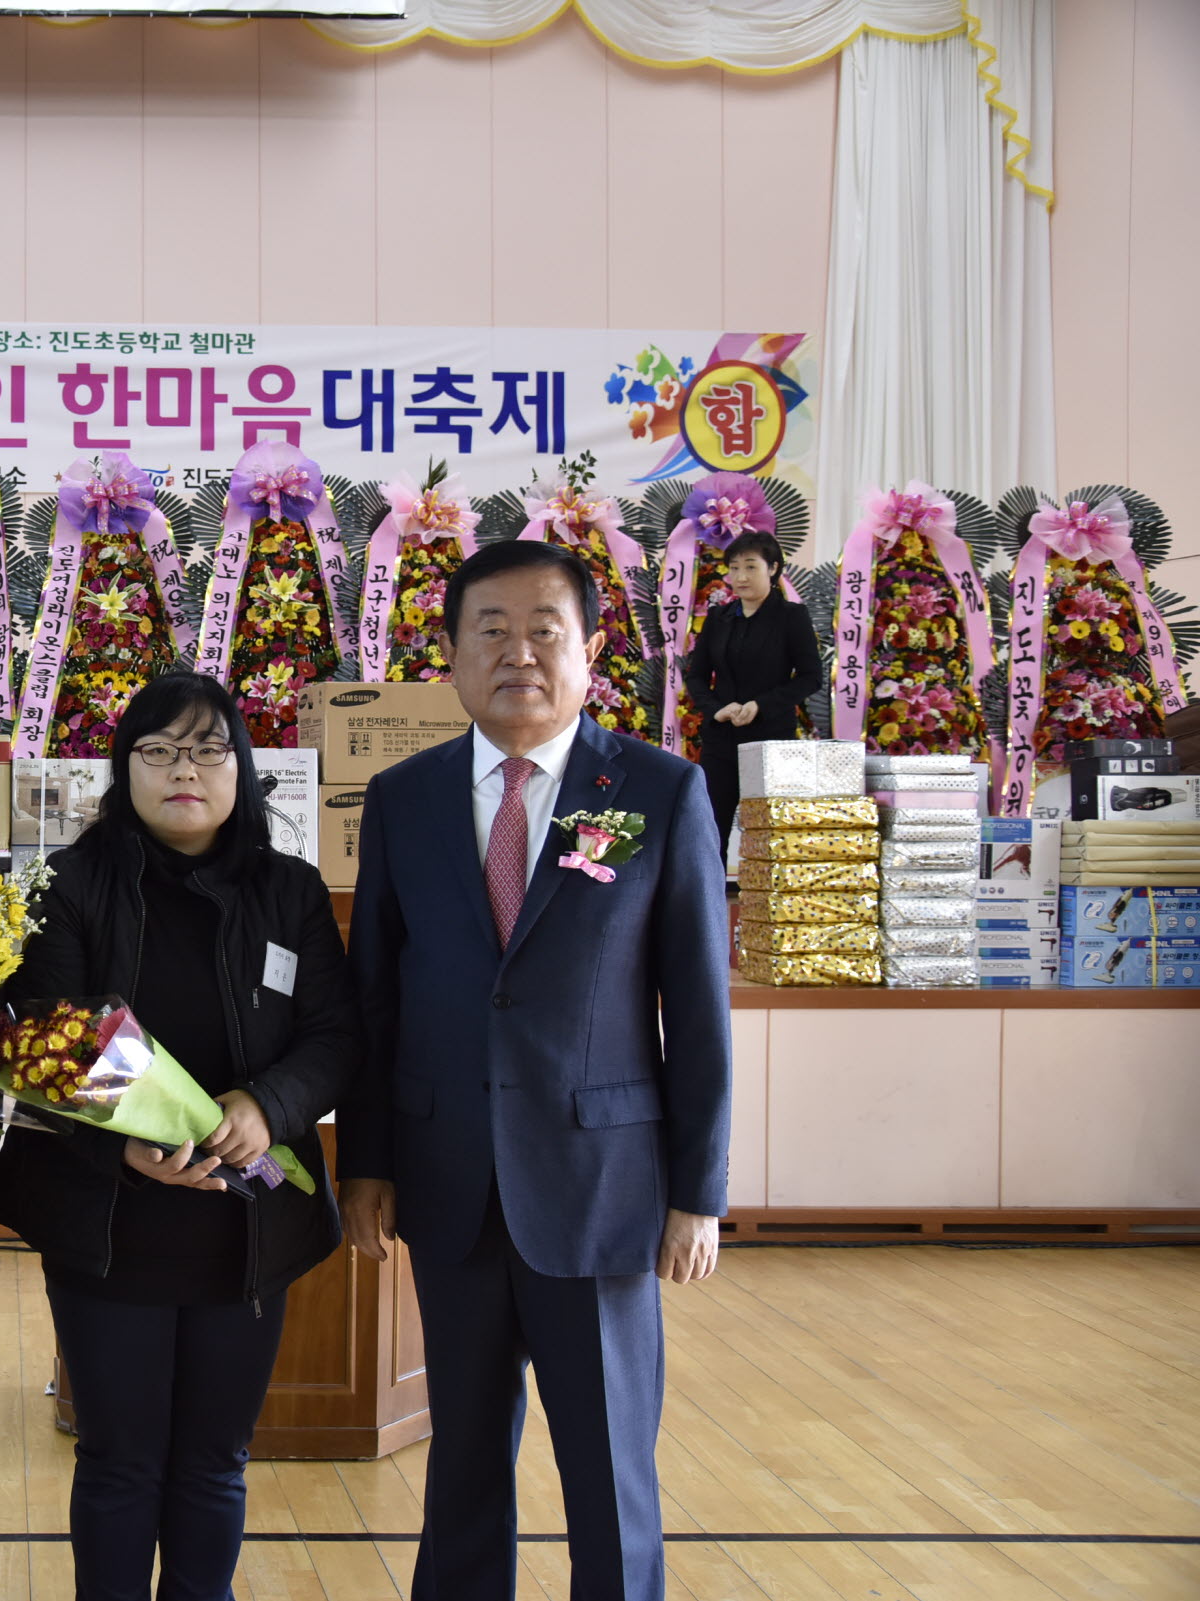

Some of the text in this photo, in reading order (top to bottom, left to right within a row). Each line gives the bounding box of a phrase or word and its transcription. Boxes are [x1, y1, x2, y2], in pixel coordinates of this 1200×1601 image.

[49, 332, 183, 354] 진도초등학교
[189, 333, 256, 354] 철마관
[57, 362, 312, 453] 한마음
[322, 366, 566, 455] 대축제
[700, 383, 764, 456] 합
[30, 544, 76, 700] 진도여성라이온스클럽
[363, 563, 390, 670] 고군청년
[838, 570, 867, 709] 광진미용실
[19, 705, 45, 742] 회장
[335, 693, 375, 703] SAMSUNG
[347, 716, 408, 728] 삼성 전자레인지
[1005, 575, 1037, 817] 진도꽃농원
[285, 768, 307, 777] Electric
[343, 818, 360, 828] 삼성
